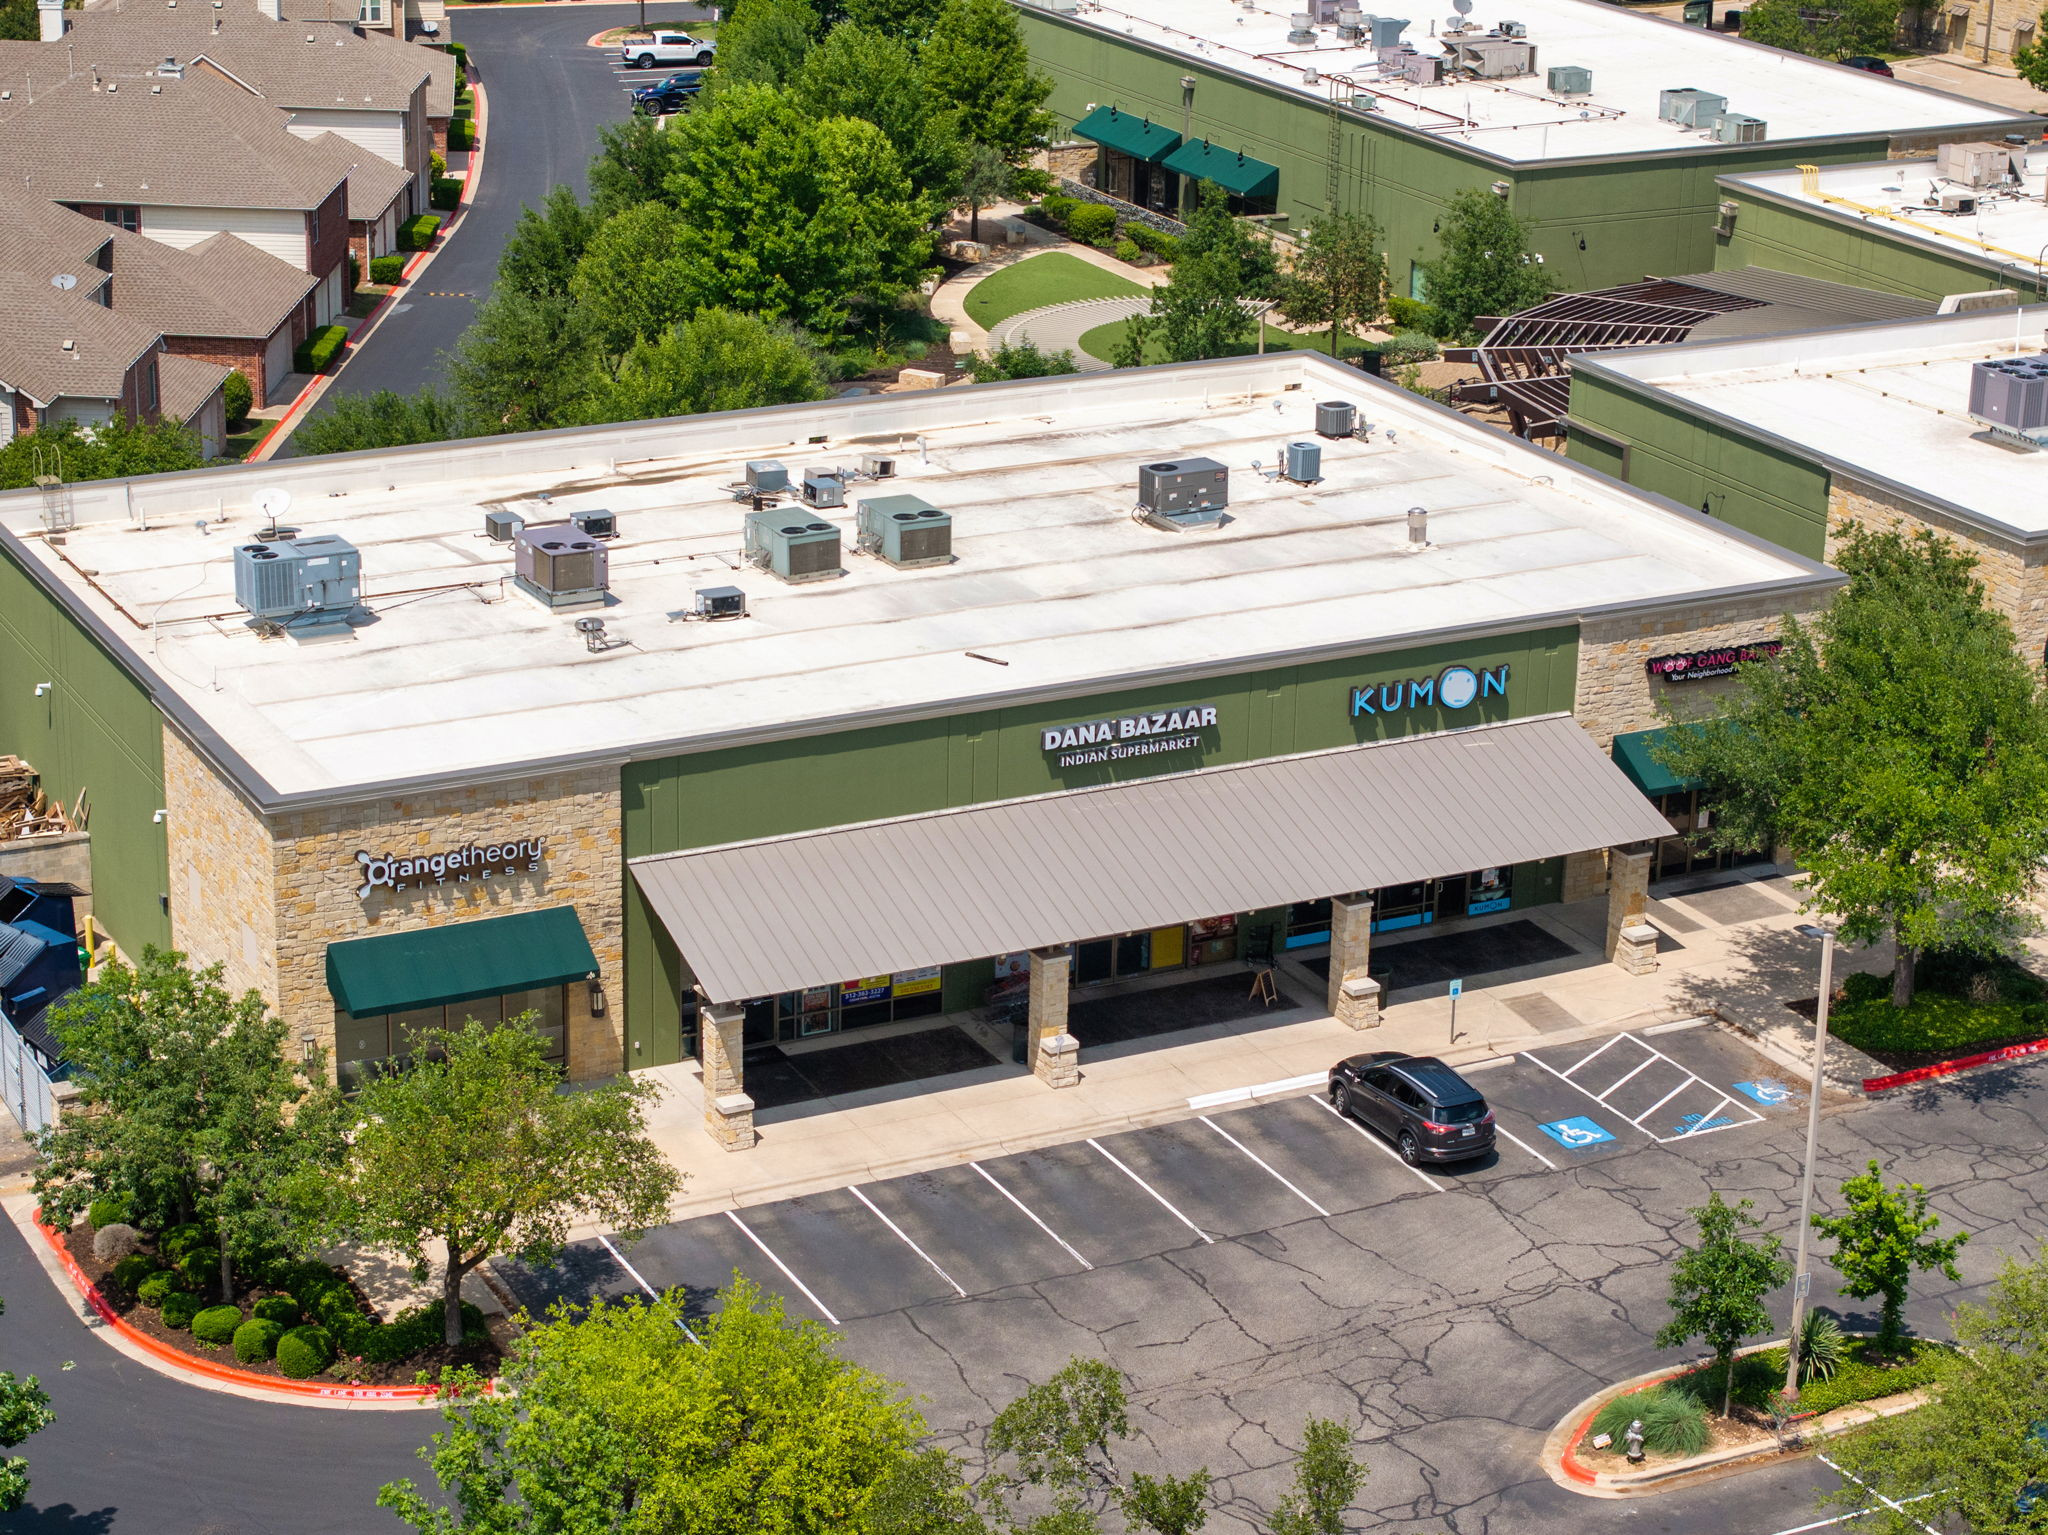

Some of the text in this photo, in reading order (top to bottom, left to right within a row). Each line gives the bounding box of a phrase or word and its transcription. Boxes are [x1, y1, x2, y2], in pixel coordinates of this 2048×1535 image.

[1671, 673, 1685, 681] Your
[1687, 667, 1733, 680] Neighborhood
[1697, 651, 1736, 668] GANG
[1354, 668, 1506, 717] KUMON
[1043, 707, 1217, 751] DANA BAZAAR
[1061, 736, 1200, 767] INDIAN SUPERMARKET
[397, 862, 539, 893] FITNESS
